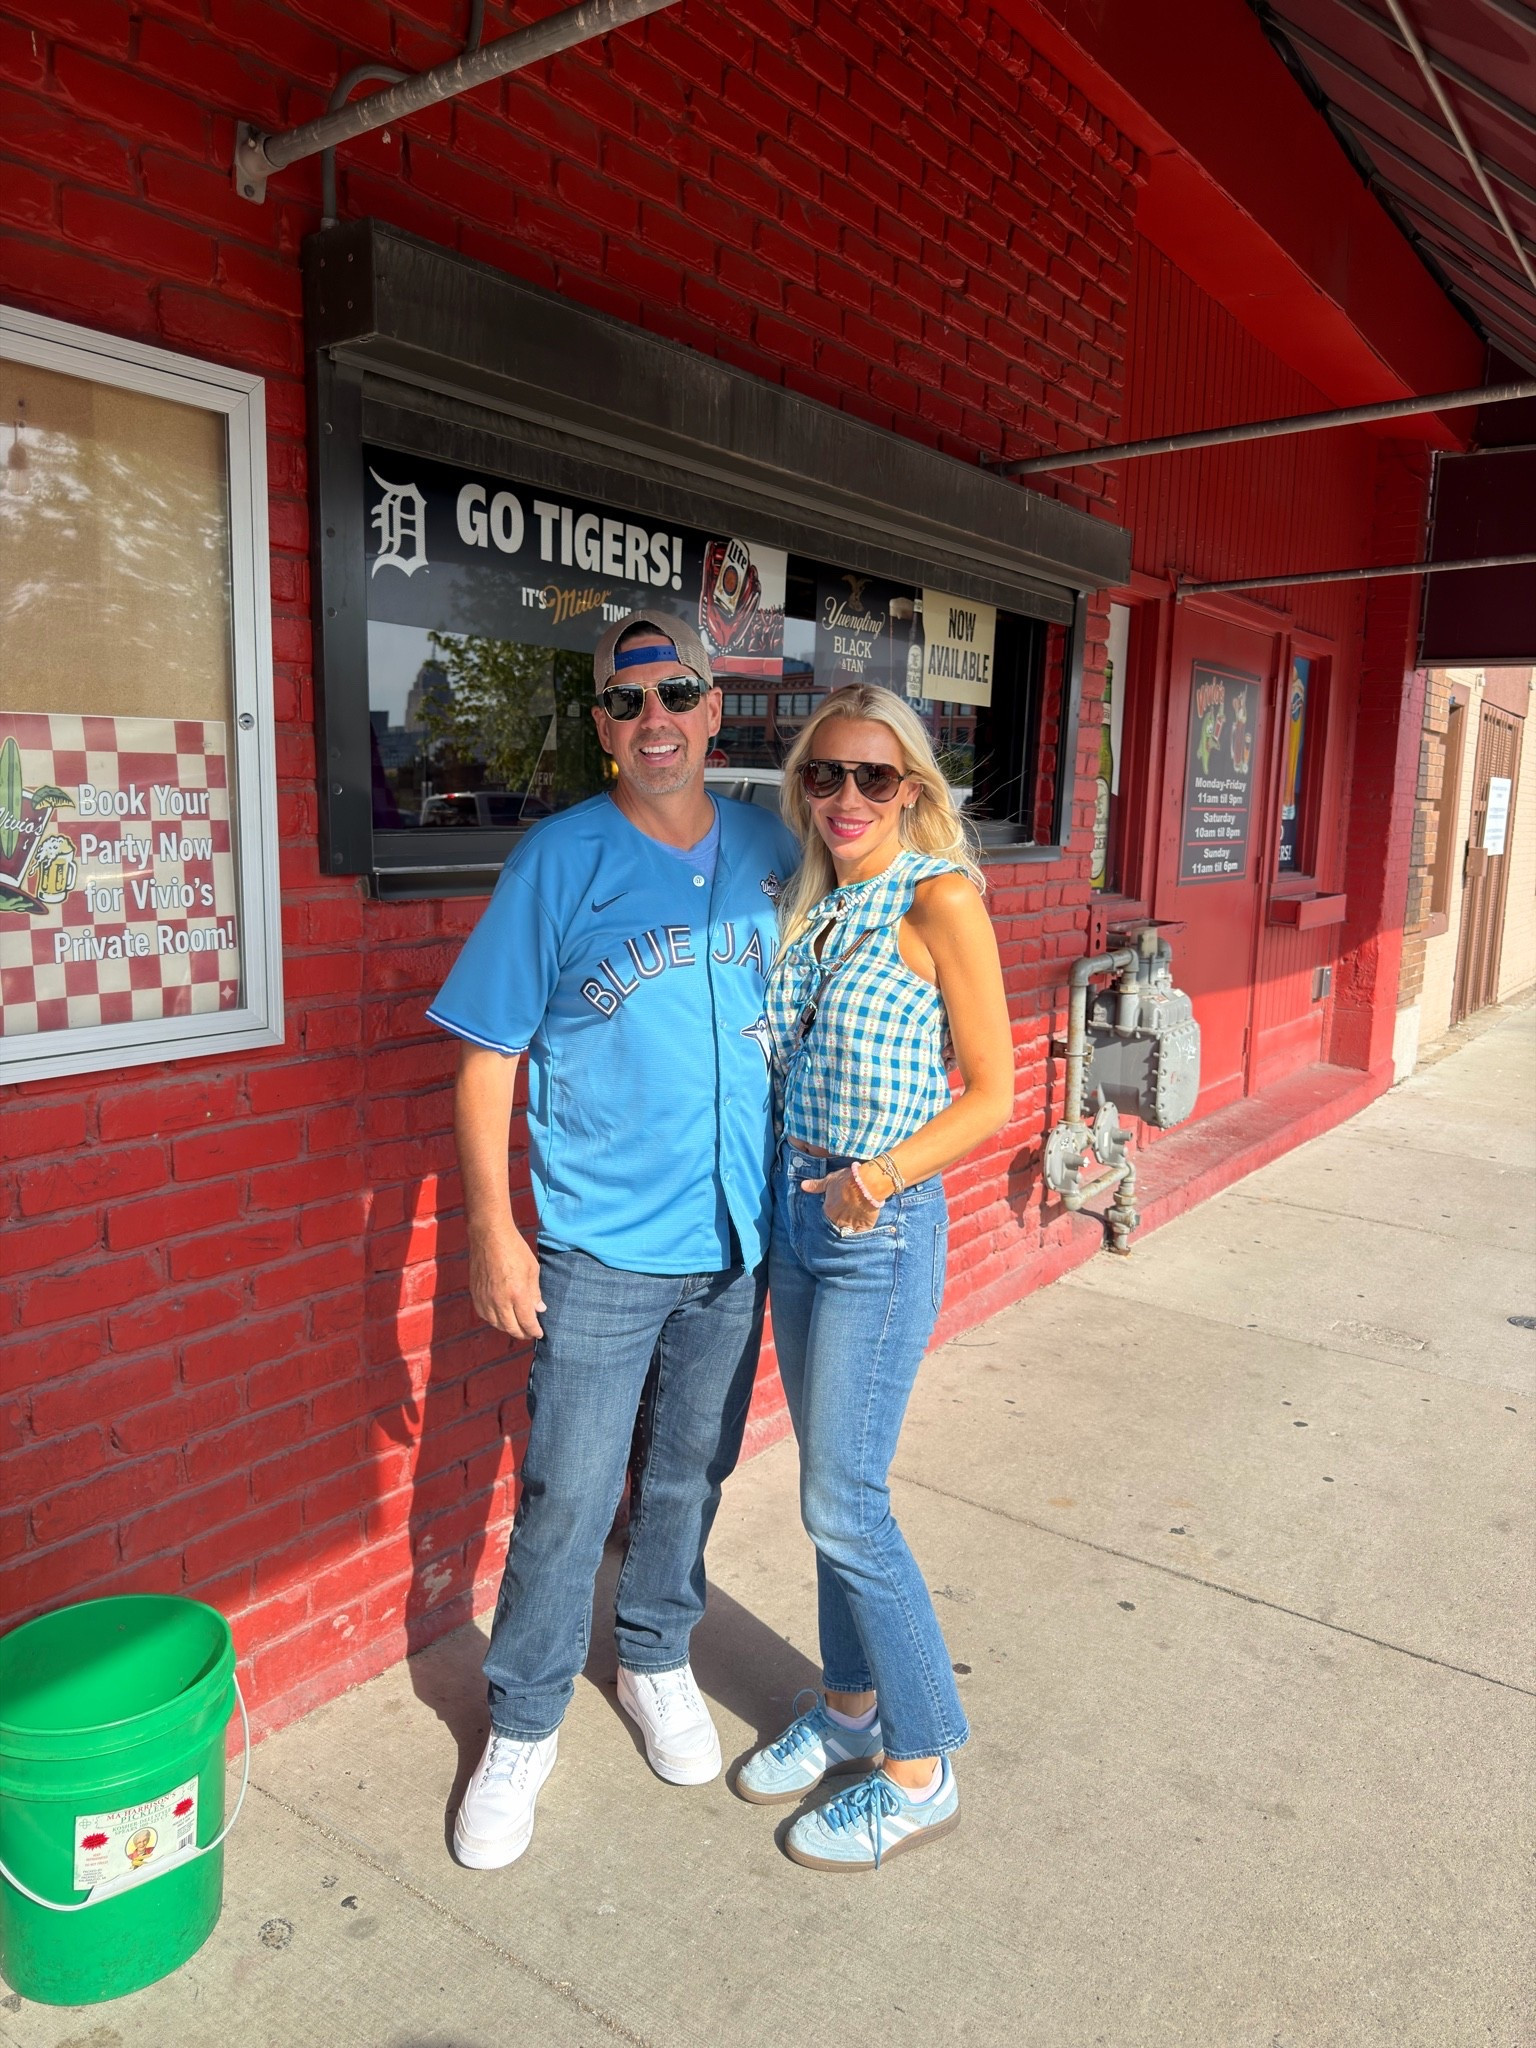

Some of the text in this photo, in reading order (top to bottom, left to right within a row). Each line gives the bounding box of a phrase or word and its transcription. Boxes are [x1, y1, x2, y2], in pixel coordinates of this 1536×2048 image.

[456, 483, 683, 591] GO TIGERS!
[727, 541, 747, 570] Lite
[521, 586, 547, 609] IT'S
[543, 584, 612, 625] Miller
[822, 596, 886, 640] Yuengling
[949, 608, 976, 643] NOW
[833, 635, 872, 659] BLACK
[928, 644, 990, 684] AVAILABLE
[77, 783, 210, 816] Book Your
[1195, 777, 1247, 792] Monday-Friday
[1198, 792, 1218, 804] 11am
[1229, 794, 1242, 806] 9pm
[1195, 827, 1240, 839] 10am til 8pm
[1203, 812, 1236, 825] Saturday
[80, 832, 213, 870] Party Now
[1203, 848, 1230, 859] Sunday
[1192, 863, 1213, 874] 11am
[1223, 861, 1238, 872] 6pm
[84, 877, 214, 913] for Vivio's
[53, 920, 235, 964] Private Room!
[580, 922, 780, 1020] BLUE JA
[106, 1813, 121, 1821] MA
[124, 1792, 176, 1816] HARRISON'S
[121, 1802, 165, 1824] PICKLES
